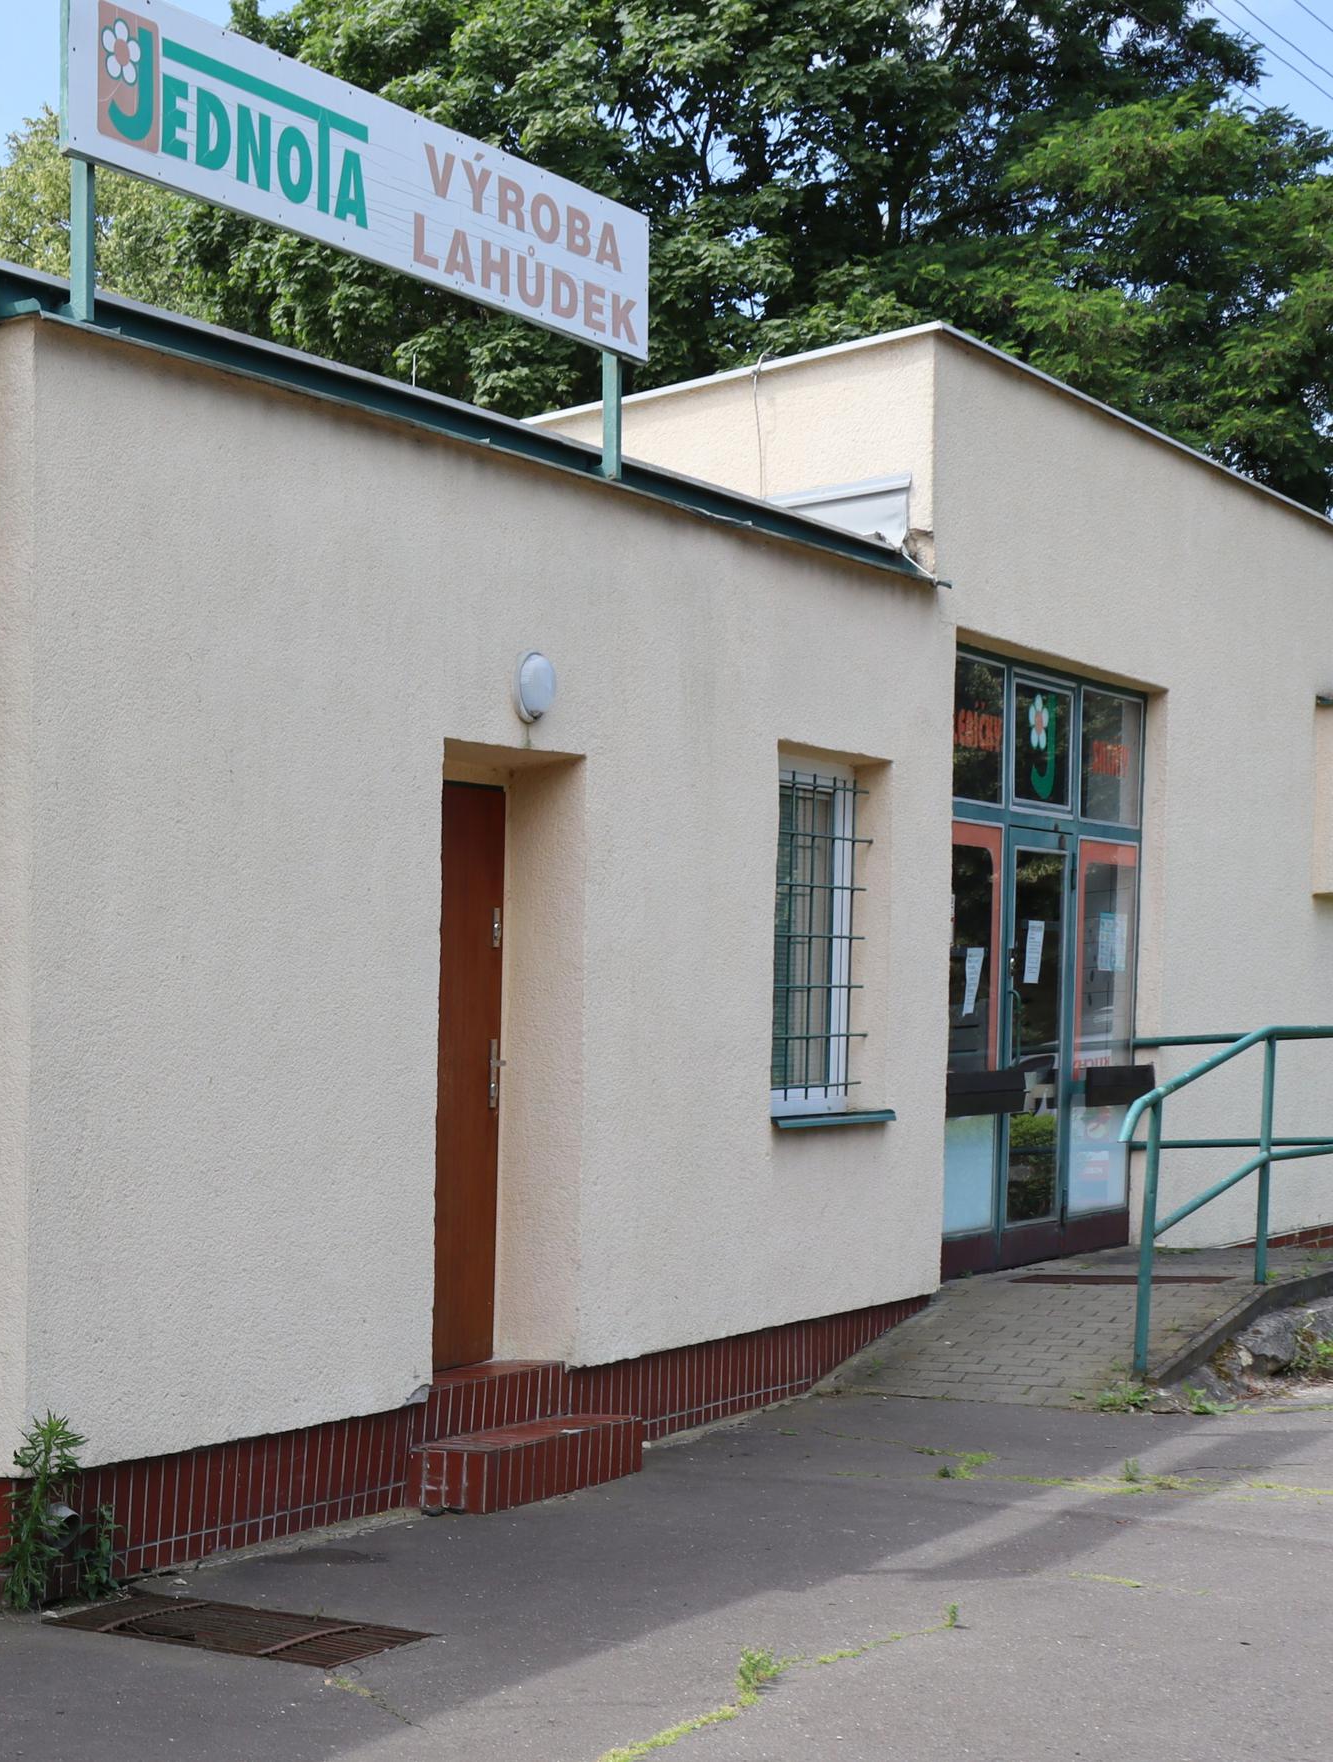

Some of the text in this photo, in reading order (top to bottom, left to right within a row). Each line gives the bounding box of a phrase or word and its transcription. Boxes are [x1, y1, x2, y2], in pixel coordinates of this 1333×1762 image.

[108, 26, 369, 229] JEDNOTA
[423, 142, 623, 273] VÝROBA
[413, 212, 639, 347] LAHŮDEK
